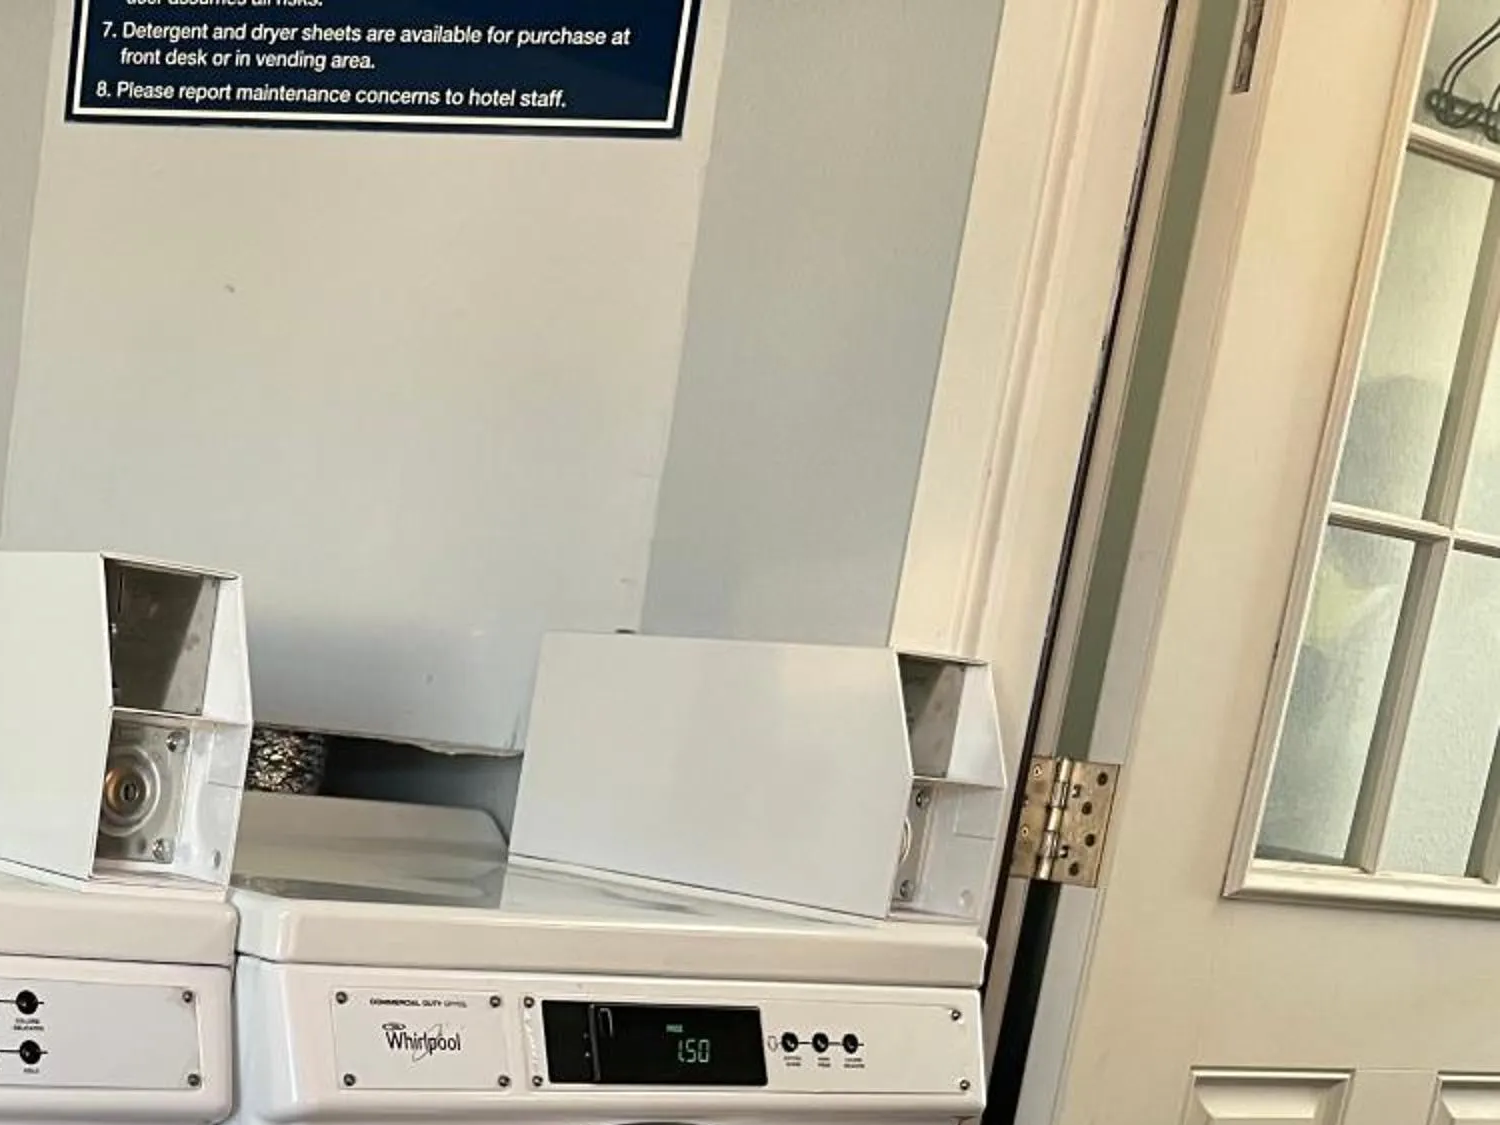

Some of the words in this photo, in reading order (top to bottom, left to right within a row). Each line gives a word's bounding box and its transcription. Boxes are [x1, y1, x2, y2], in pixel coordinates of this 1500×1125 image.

[102, 21, 117, 38] 7.
[122, 21, 209, 43] Detergent
[213, 23, 247, 40] and
[251, 24, 299, 45] dryer
[301, 24, 362, 42] sheets
[366, 28, 396, 43] are
[400, 26, 482, 44] available
[487, 26, 512, 44] for
[517, 27, 607, 48] purchase
[611, 28, 632, 46] at
[121, 48, 161, 65] front
[165, 49, 207, 66] desk
[212, 52, 233, 67] or
[235, 50, 251, 67] in
[256, 50, 326, 72] vending
[331, 54, 376, 70] area.
[95, 81, 112, 98] 8.
[116, 81, 175, 100] Please
[178, 83, 232, 103] report
[236, 84, 351, 103] maintenance
[355, 90, 441, 106] concerns
[445, 88, 464, 106] to
[468, 88, 516, 107] hotel
[519, 89, 567, 108] staff.
[385, 1031, 462, 1056] Whirlpool
